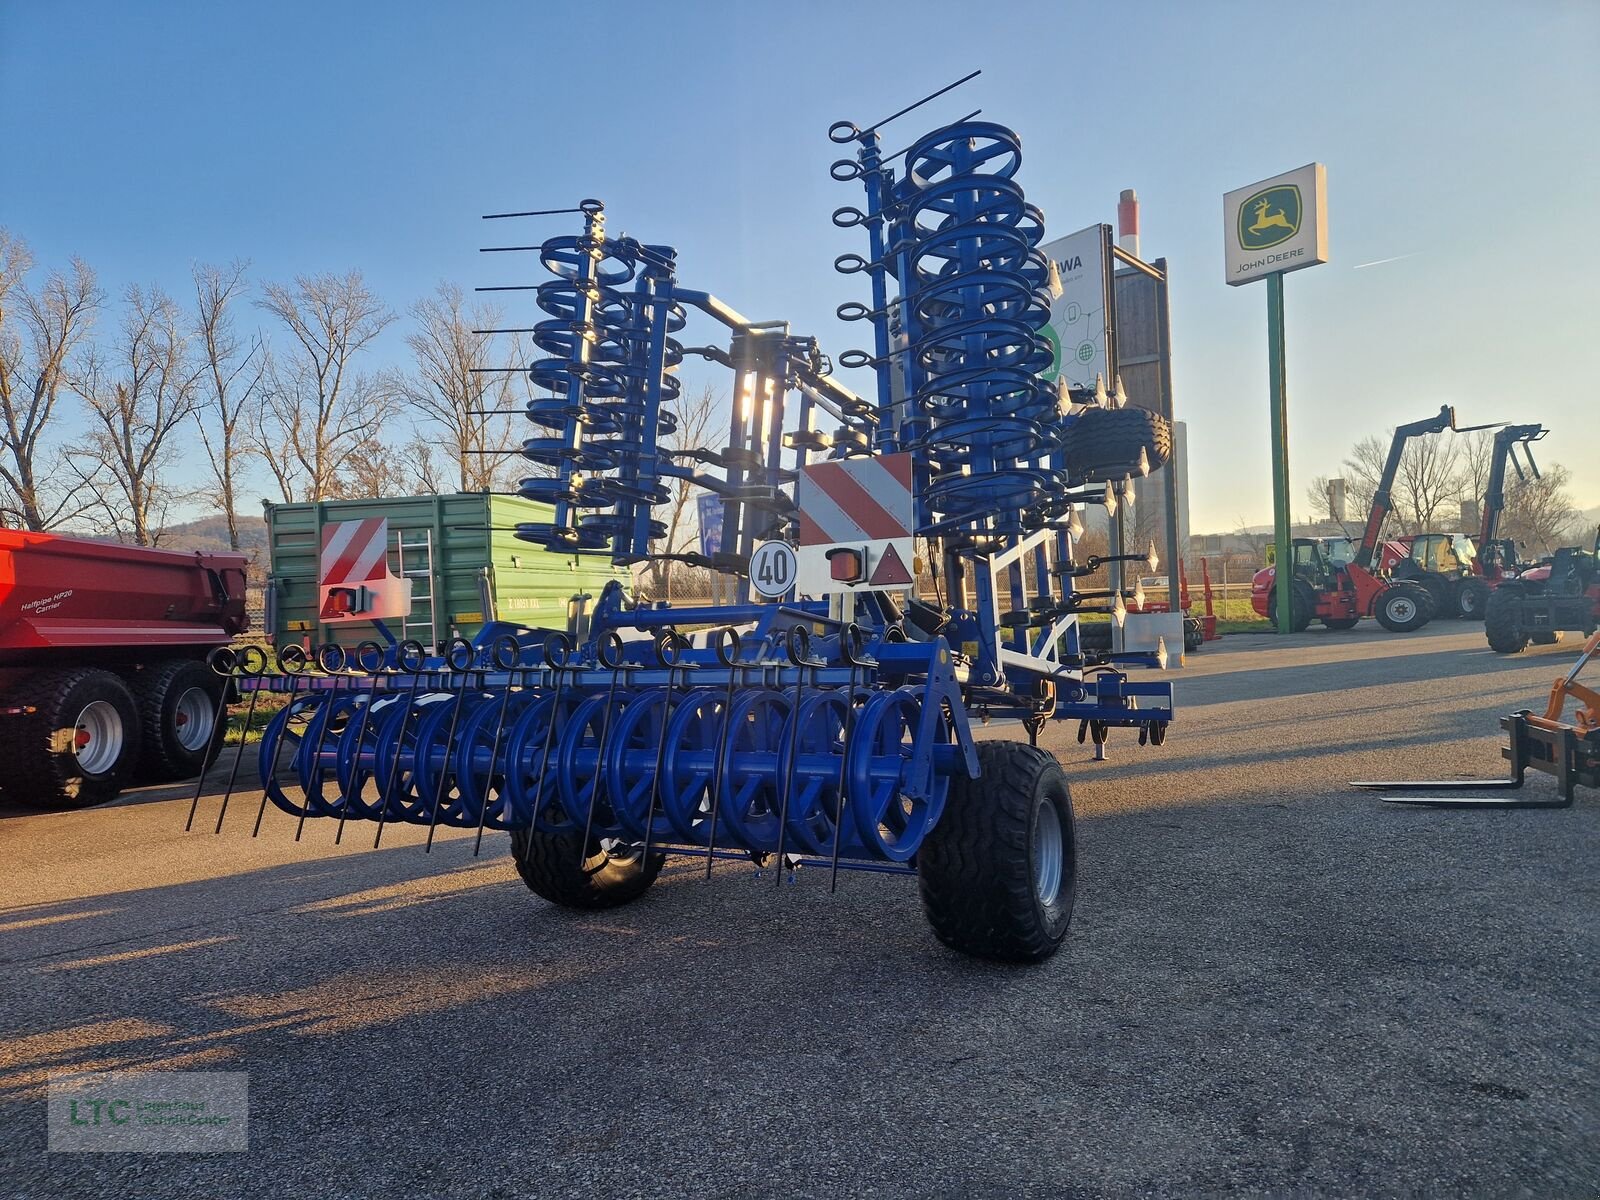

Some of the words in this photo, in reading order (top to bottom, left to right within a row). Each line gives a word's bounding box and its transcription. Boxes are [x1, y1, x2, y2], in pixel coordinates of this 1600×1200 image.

[1236, 259, 1265, 274] JOHN
[1266, 247, 1305, 265] DEERE
[758, 549, 788, 586] 40
[53, 589, 73, 601] HP20
[35, 601, 62, 614] Carrier
